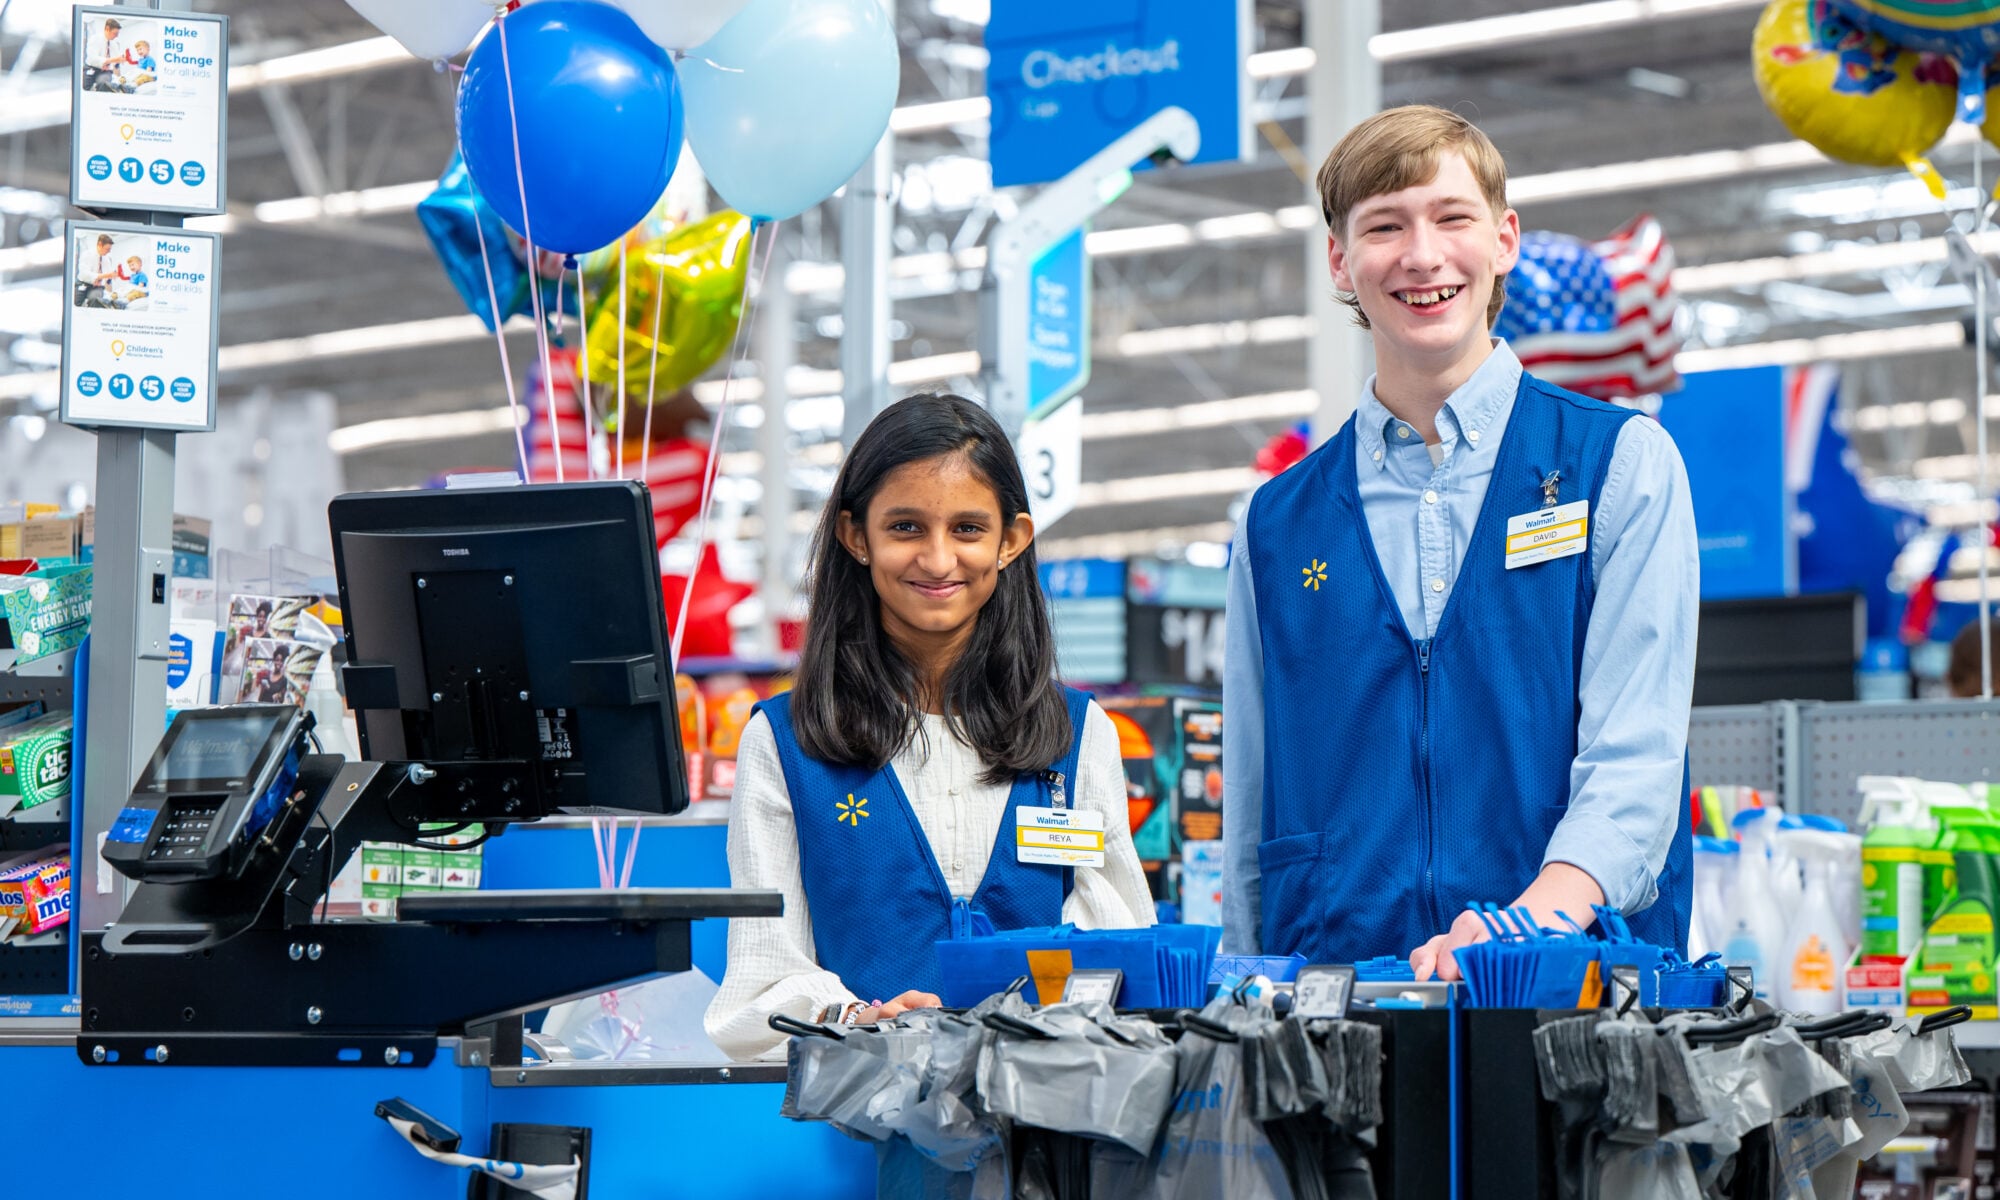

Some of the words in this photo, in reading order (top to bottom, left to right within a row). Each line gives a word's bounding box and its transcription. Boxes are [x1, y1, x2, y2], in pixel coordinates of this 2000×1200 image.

[164, 26, 198, 38] Make
[164, 40, 184, 52] Big
[164, 52, 213, 68] Change
[1021, 39, 1179, 88] Checkout
[164, 66, 177, 76] for
[179, 68, 190, 76] all
[192, 68, 211, 78] kids
[136, 129, 172, 138] Children's
[122, 160, 138, 179] $1
[152, 163, 170, 182] $5
[157, 241, 190, 253] Make
[156, 255, 176, 268] Big
[156, 268, 205, 283] Change
[171, 284, 182, 292] all
[184, 284, 203, 294] kids
[126, 345, 163, 354] Children's
[113, 377, 127, 395] $1
[142, 379, 160, 397] $5
[1036, 448, 1055, 500] 3
[1526, 515, 1556, 528] Walmart
[1533, 531, 1557, 543] DAVID
[442, 548, 470, 556] TOSHIBA
[30, 606, 69, 632] ENERGY
[181, 738, 241, 755] Walmart
[44, 749, 68, 768] tic
[40, 764, 68, 783] tac
[1036, 816, 1069, 826] Walmart
[1049, 834, 1072, 843] REYA
